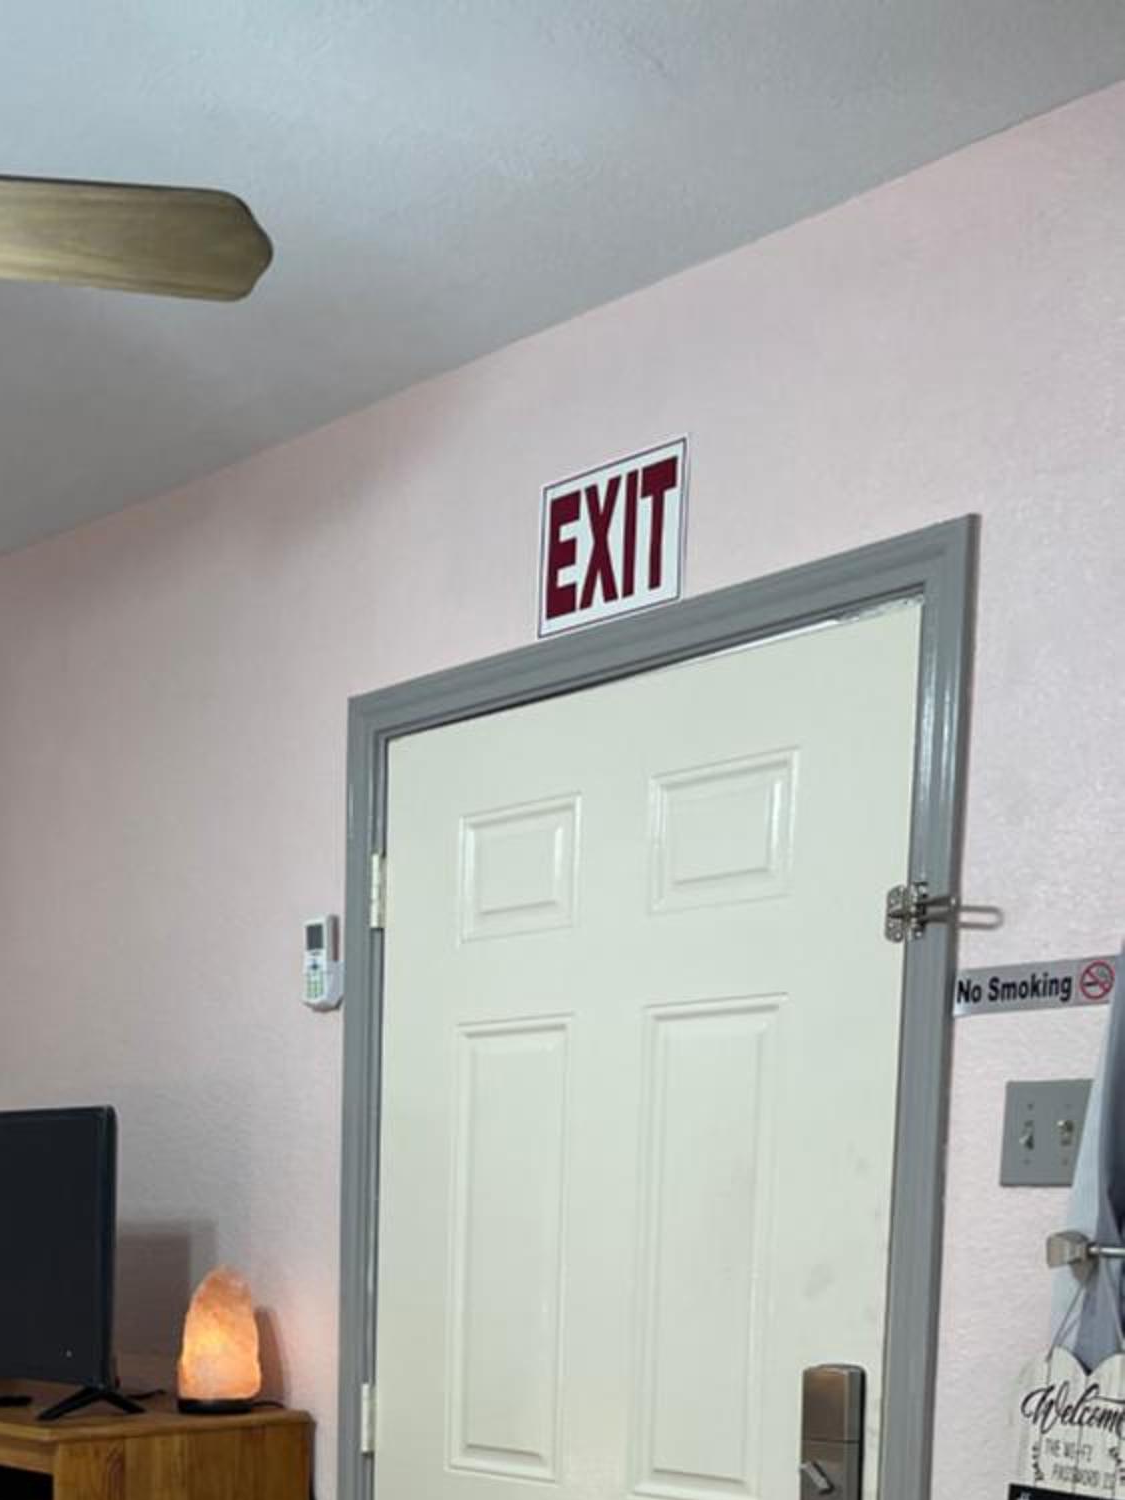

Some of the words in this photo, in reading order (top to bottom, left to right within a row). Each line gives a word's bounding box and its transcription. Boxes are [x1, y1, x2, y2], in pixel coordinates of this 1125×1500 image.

[546, 455, 679, 620] EXIT
[956, 979, 982, 1004] No
[988, 972, 1073, 1002] Smoking
